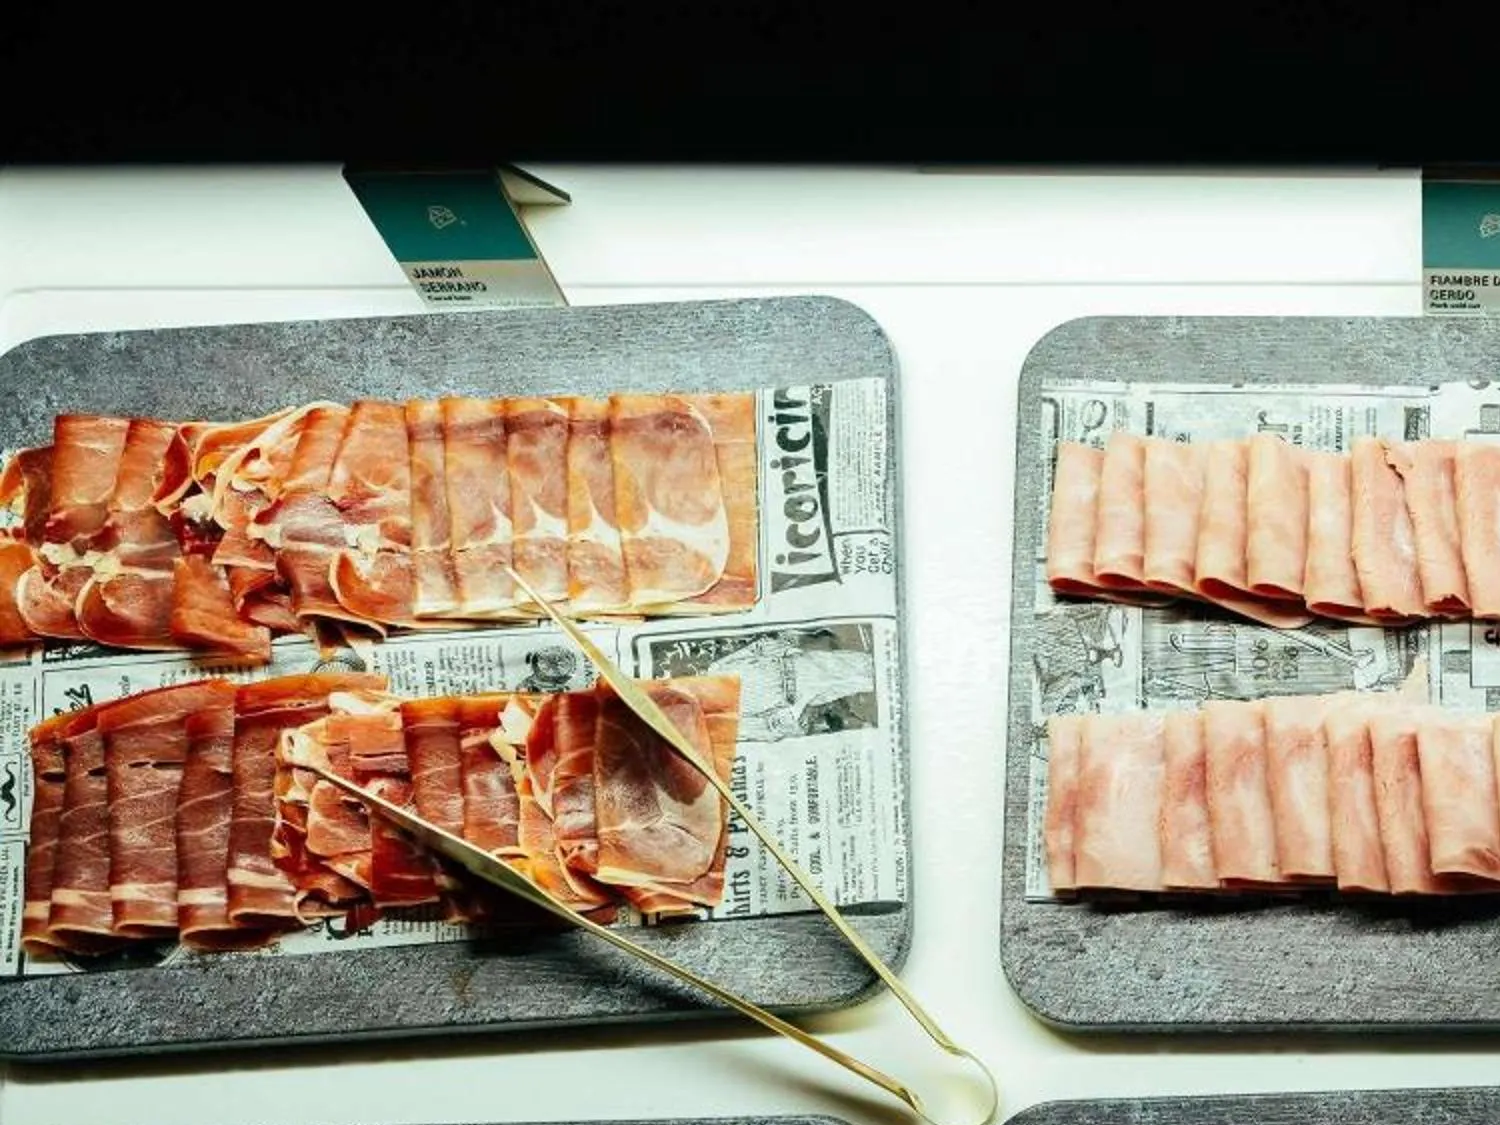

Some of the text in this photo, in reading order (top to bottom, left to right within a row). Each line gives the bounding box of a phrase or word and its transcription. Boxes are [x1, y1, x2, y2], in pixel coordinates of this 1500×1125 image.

[419, 281, 488, 293] SERRANO
[1430, 275, 1489, 287] FIAMBRE
[1429, 289, 1476, 301] CERDO
